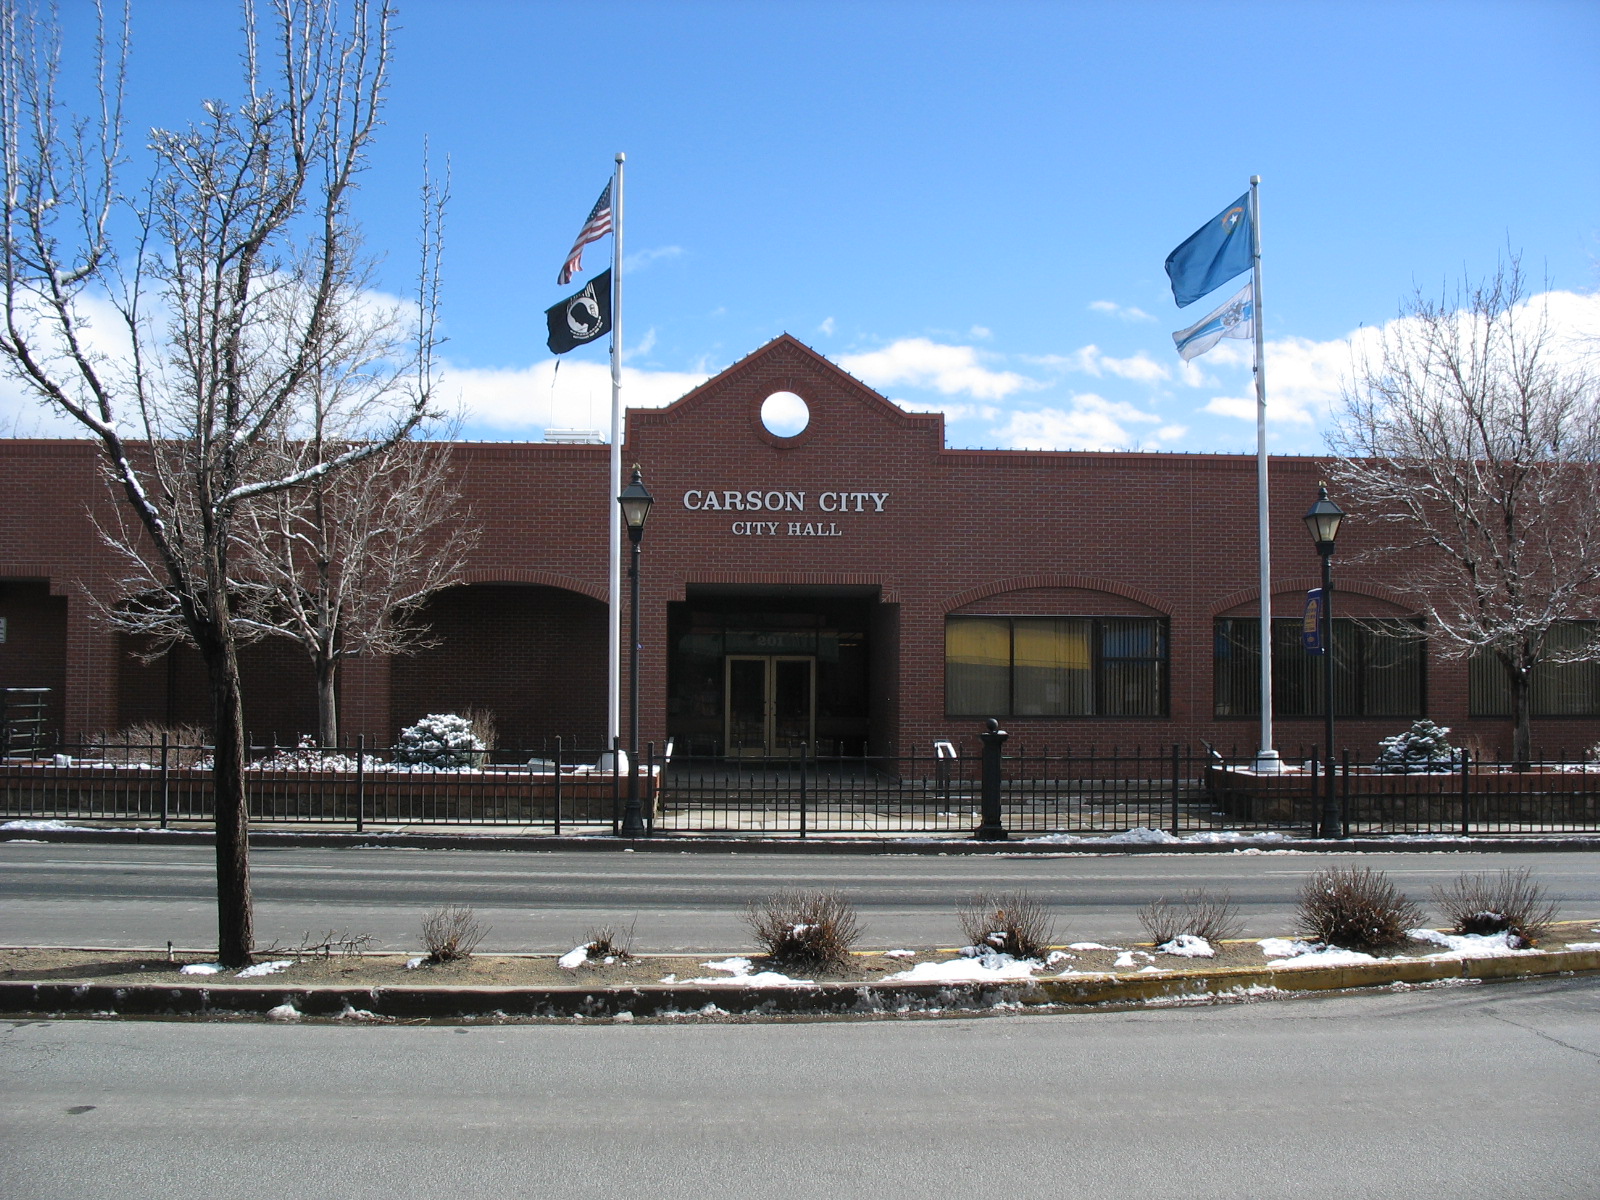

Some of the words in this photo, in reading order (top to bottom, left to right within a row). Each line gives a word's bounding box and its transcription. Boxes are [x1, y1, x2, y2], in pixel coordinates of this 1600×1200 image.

[683, 490, 806, 511] CARSON
[818, 491, 890, 512] CITY
[731, 521, 780, 536] CITY
[787, 522, 843, 536] HALL
[757, 635, 784, 647] 201
